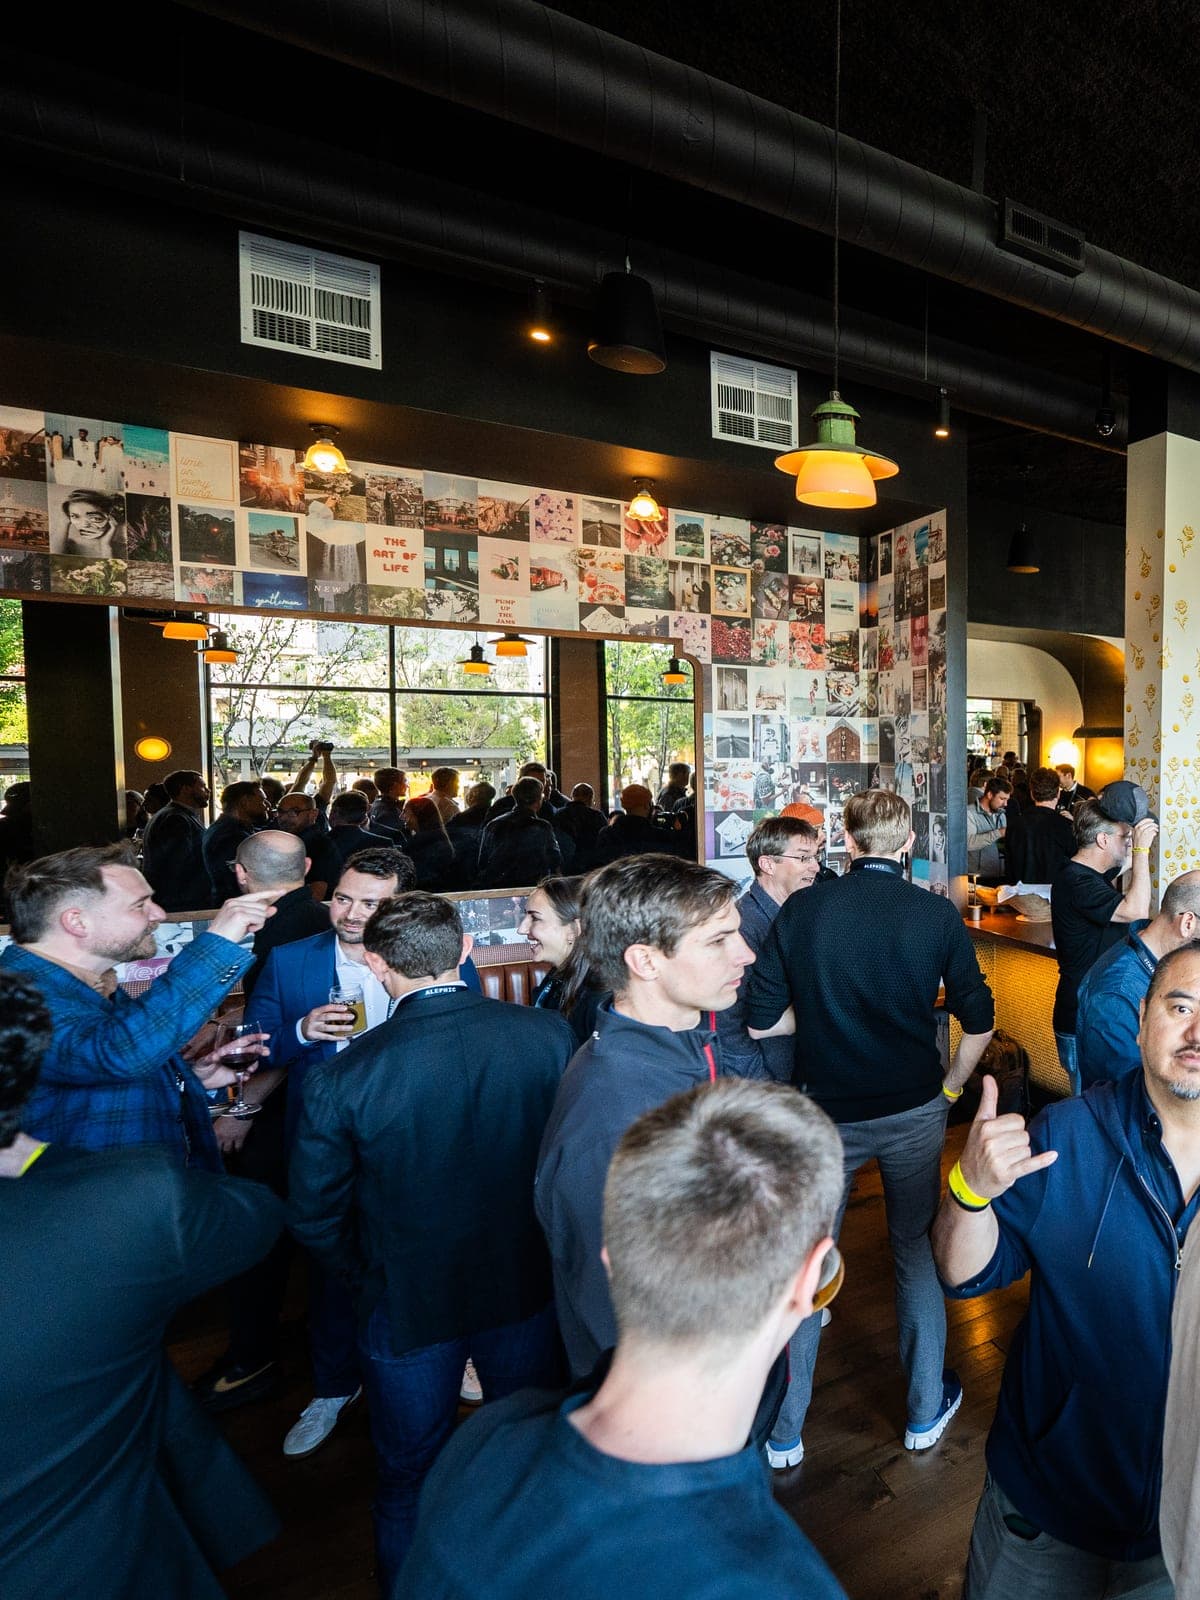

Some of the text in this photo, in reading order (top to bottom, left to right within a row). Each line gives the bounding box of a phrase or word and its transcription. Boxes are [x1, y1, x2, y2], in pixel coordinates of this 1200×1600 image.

[384, 537, 407, 547] THE
[373, 550, 417, 560] ART OF
[383, 564, 409, 573] LIFE
[314, 585, 341, 593] NEW
[425, 986, 457, 996] ALEPHIC
